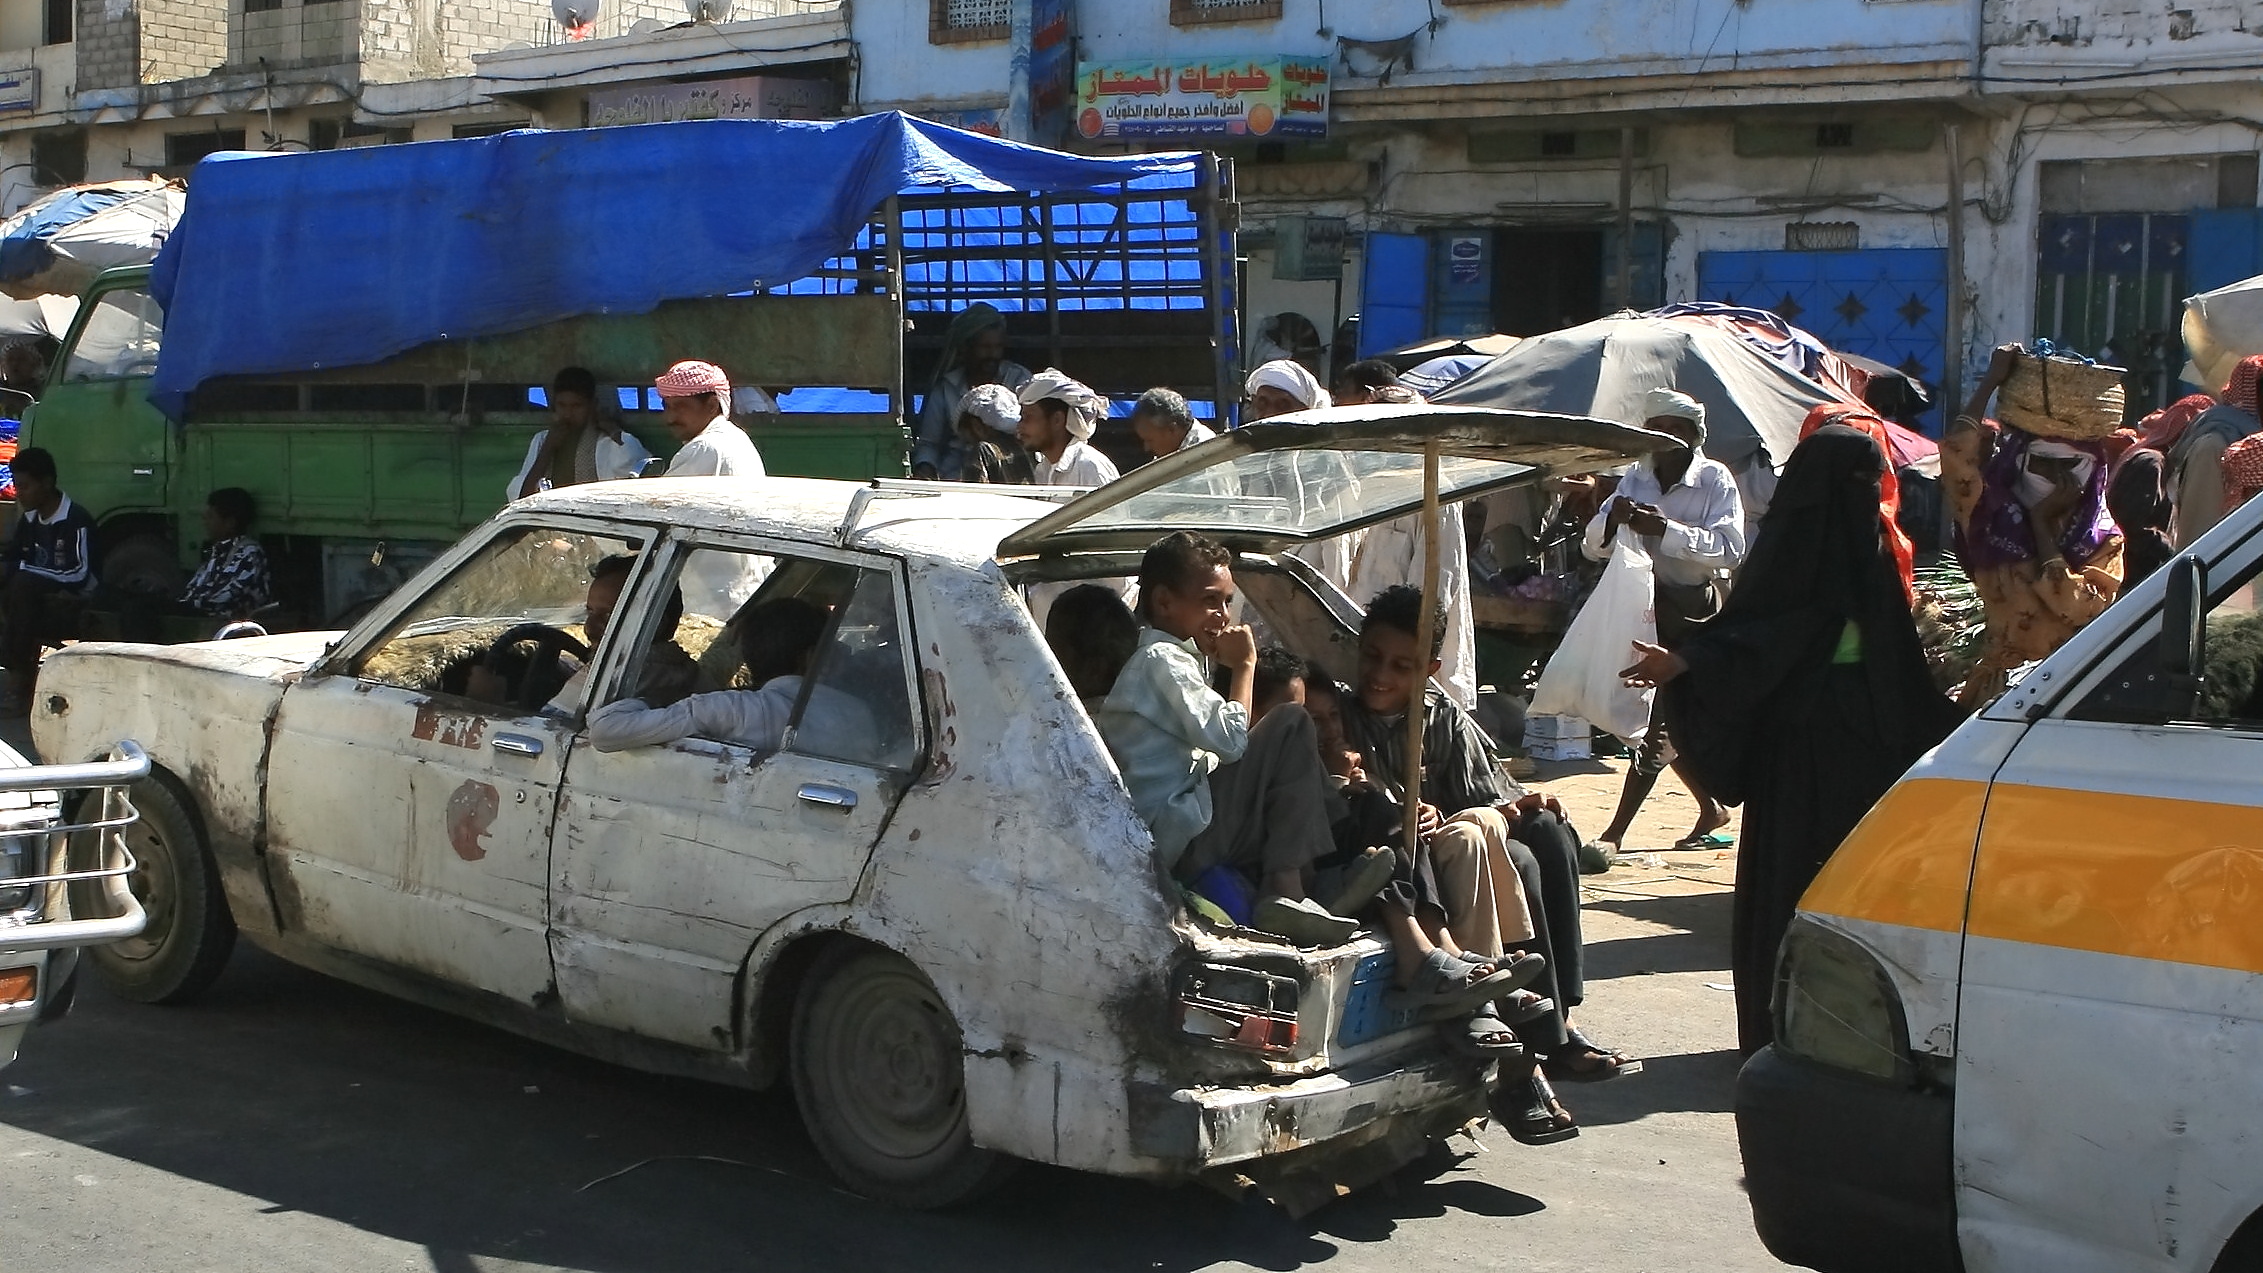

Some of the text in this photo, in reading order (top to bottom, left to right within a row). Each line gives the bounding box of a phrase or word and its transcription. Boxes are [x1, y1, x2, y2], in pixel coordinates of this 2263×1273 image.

[1086, 66, 1171, 103] الممتاز
[1179, 64, 1270, 98] حلويات
[1106, 104, 1142, 120] الحلويات
[1167, 105, 1191, 119] جميع
